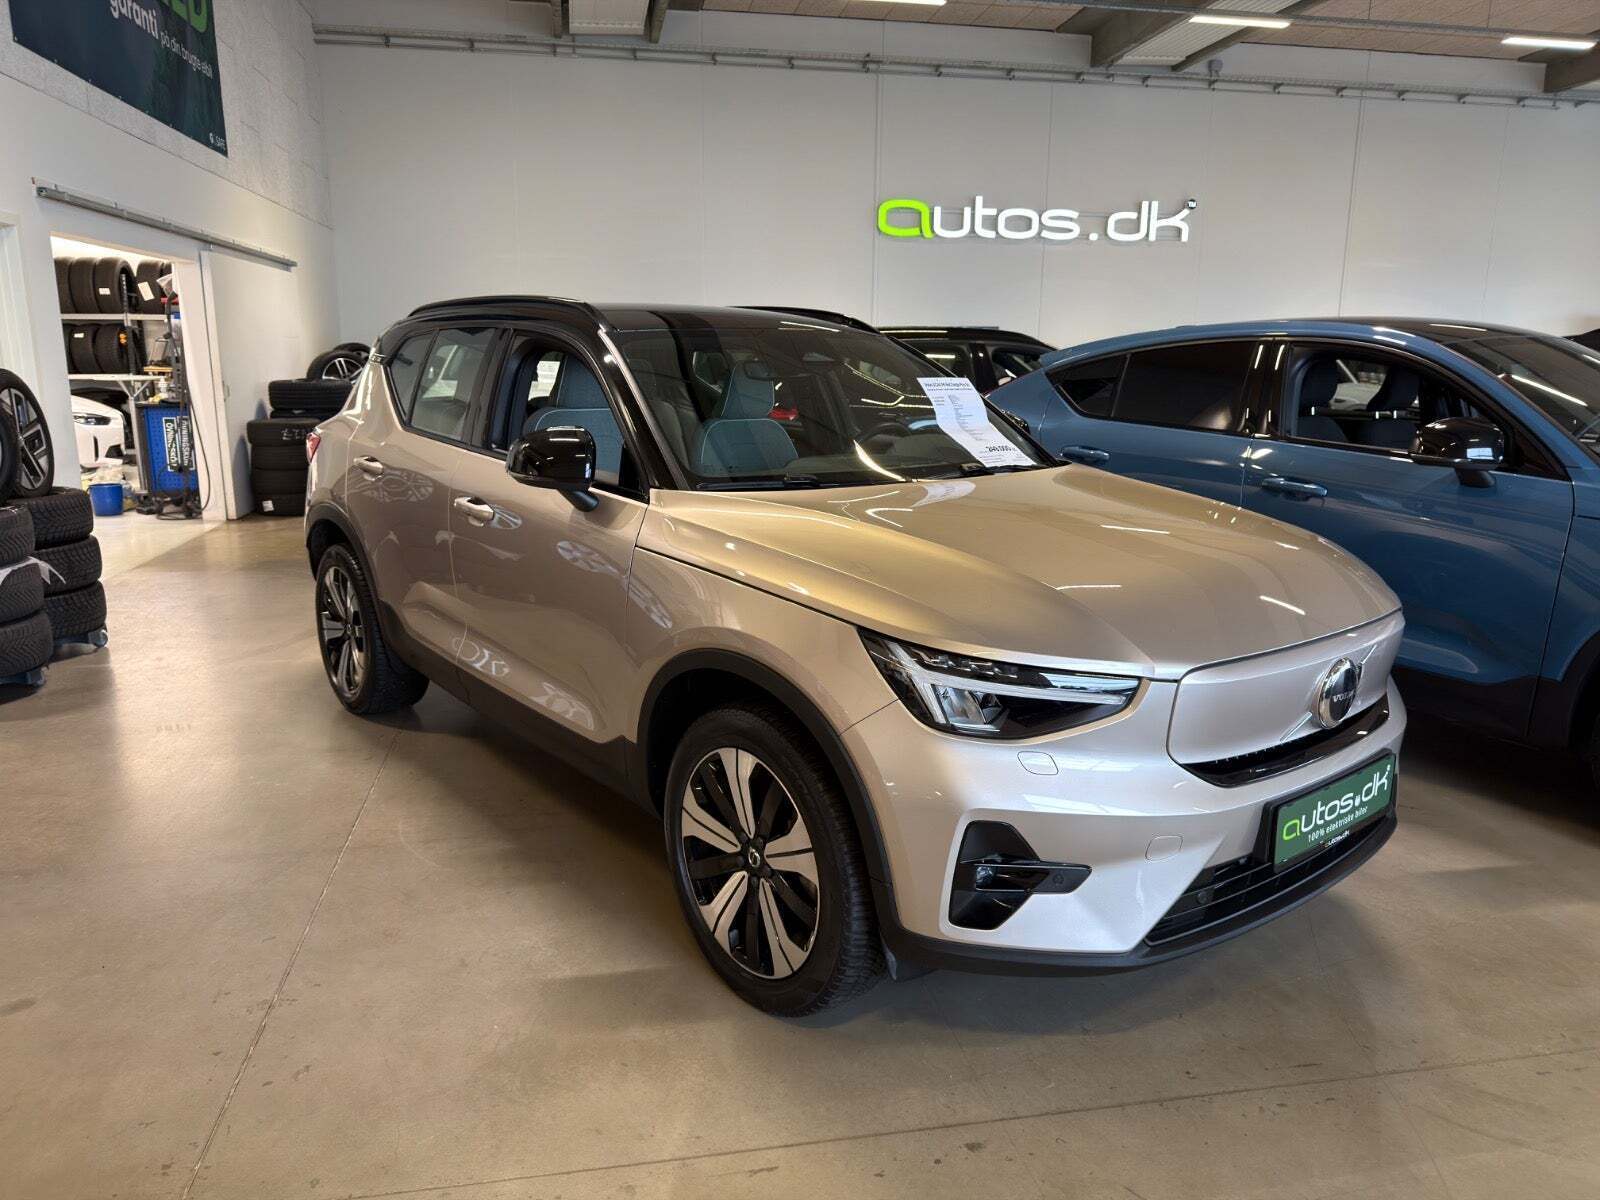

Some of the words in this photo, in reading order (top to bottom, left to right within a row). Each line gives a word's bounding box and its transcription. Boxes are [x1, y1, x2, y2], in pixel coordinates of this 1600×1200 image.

[110, 0, 159, 39] garanti
[878, 195, 1191, 242] autos.dk
[1282, 764, 1391, 841] autos.dk
[1308, 828, 1325, 844] 100%
